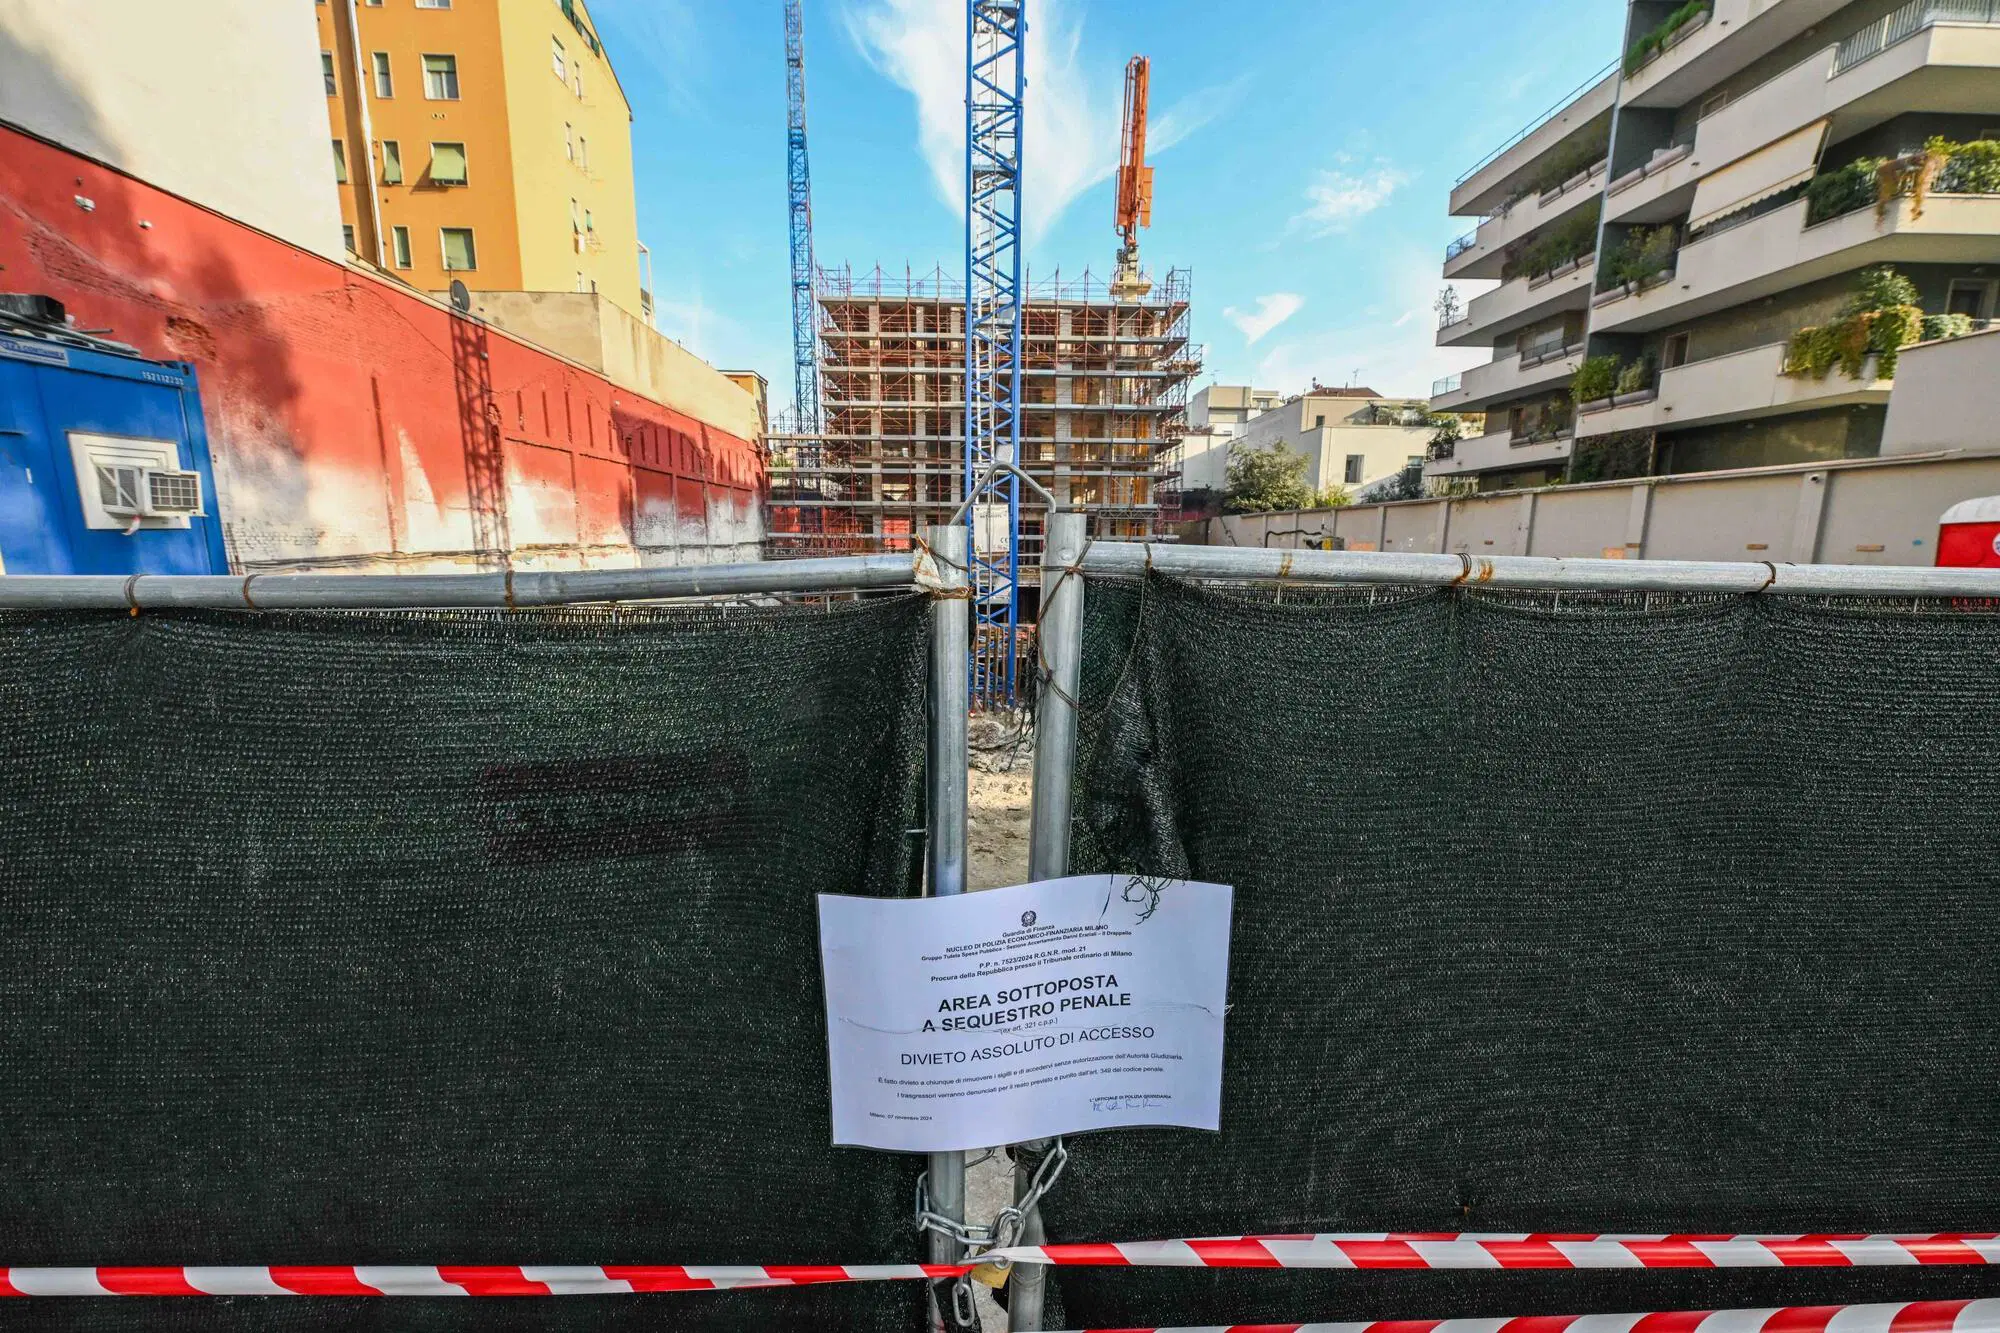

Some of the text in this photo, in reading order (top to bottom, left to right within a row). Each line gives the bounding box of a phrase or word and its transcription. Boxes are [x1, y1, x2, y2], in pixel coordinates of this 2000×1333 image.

[946, 944, 973, 953] NUCLEO
[982, 939, 1006, 949] POLIZIA
[1007, 927, 1083, 944] ECONOMICO-FINANZIARIA
[1084, 924, 1109, 932] MILANO
[961, 950, 978, 958] Spesa
[979, 946, 1002, 955] Pubblica
[1006, 942, 1027, 951] Sezione
[1027, 935, 1062, 947] Accertamento
[1062, 932, 1078, 941] Danni
[1107, 929, 1132, 937] Drappello
[1002, 924, 1055, 938] Guardia di Finanza
[930, 973, 958, 982] Procura
[959, 968, 976, 979] della
[976, 965, 1014, 977] Repubblica
[1014, 960, 1037, 971] presso
[1043, 954, 1072, 965] Tribunale
[1073, 950, 1102, 960] ordinario
[1110, 948, 1133, 957] Milano
[1001, 954, 1033, 965] 7523/2024
[1061, 947, 1077, 955] mod.
[938, 974, 1119, 1013] AREA SOTTOPOSTA
[922, 993, 1131, 1033] A SEQUESTRO PENALE
[1024, 1021, 1036, 1029] 321
[901, 1026, 1155, 1066] DIVIETO ASSOLUTO DI ACCESSO
[926, 1079, 954, 1087] chiunque
[962, 1074, 993, 1084] rimuovere
[997, 1071, 1013, 1080] sigilli
[1025, 1063, 1054, 1074] accedervi
[1054, 1059, 1072, 1068] senza
[1072, 1055, 1114, 1065] autorizzazione
[966, 1087, 997, 1096] denunciati
[998, 1085, 1009, 1093] per
[1014, 1080, 1030, 1089] reato
[1030, 1076, 1054, 1087] previsto
[1059, 1073, 1078, 1081] punito
